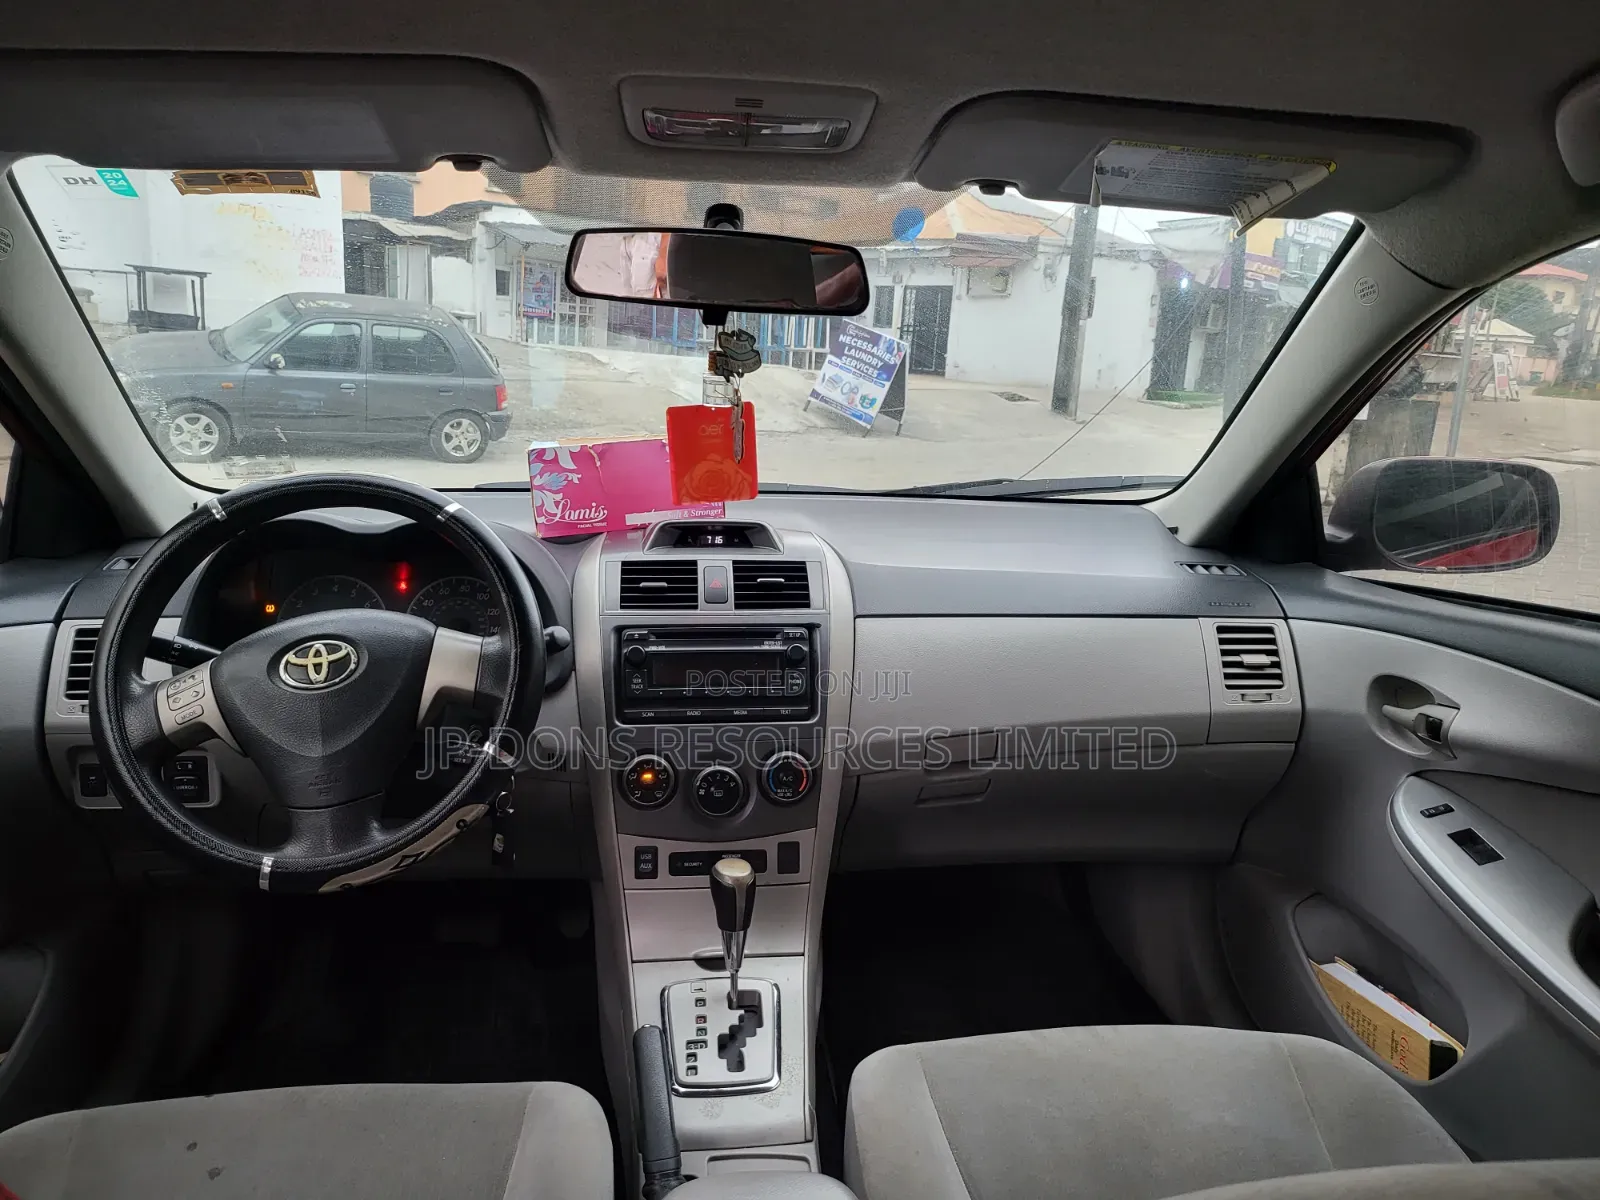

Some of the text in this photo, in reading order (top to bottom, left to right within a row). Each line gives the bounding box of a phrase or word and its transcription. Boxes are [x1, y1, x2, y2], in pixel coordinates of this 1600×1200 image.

[62, 177, 97, 185] DH
[838, 334, 895, 365] NECESSARIES
[844, 346, 884, 368] LAUNDRY
[840, 356, 879, 378] SERVICES
[543, 498, 608, 525] Lamis
[690, 508, 722, 517] Stronger
[422, 599, 434, 607] 40
[180, 709, 198, 721] MODE
[723, 774, 729, 782] 3
